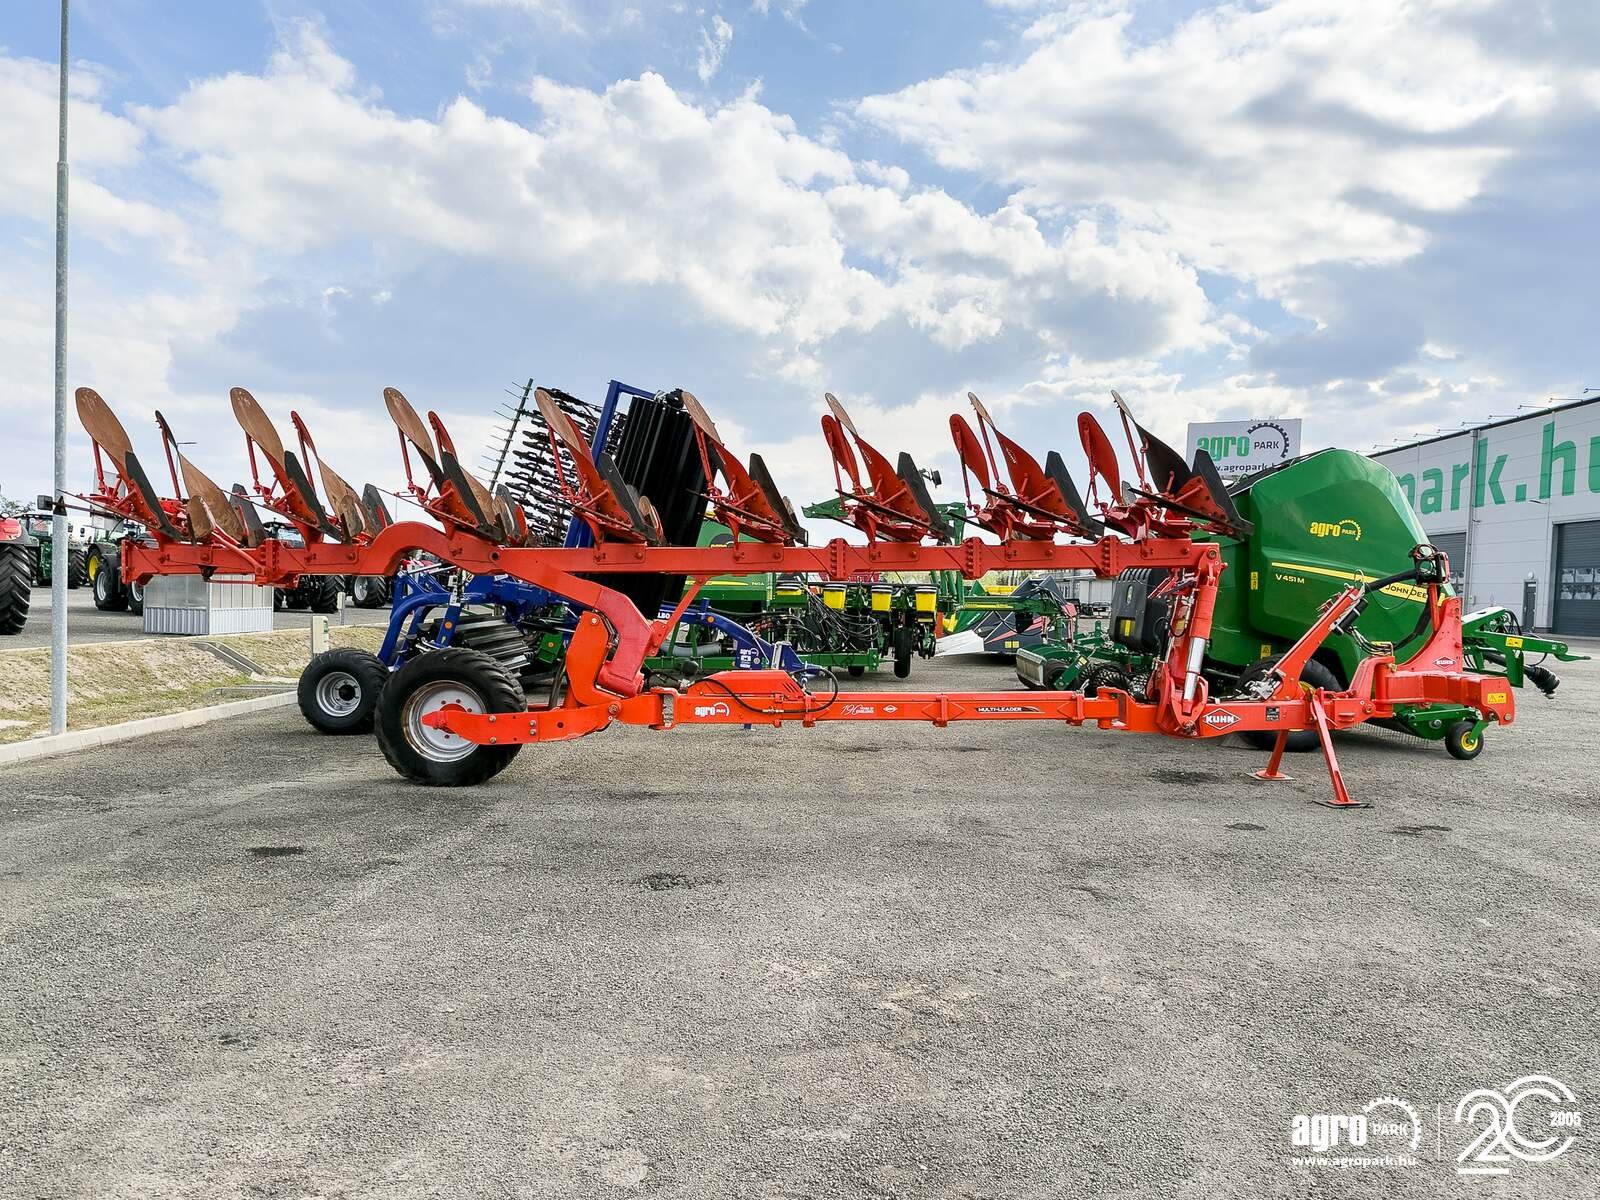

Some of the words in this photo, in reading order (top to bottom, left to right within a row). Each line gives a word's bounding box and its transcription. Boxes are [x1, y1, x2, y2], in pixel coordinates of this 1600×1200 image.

[1197, 436, 1250, 462] agro
[1254, 441, 1279, 450] PARK
[1310, 522, 1341, 537] agro
[1385, 584, 1409, 594] JOHN
[694, 706, 716, 717] agro
[1205, 715, 1235, 724] KUHN
